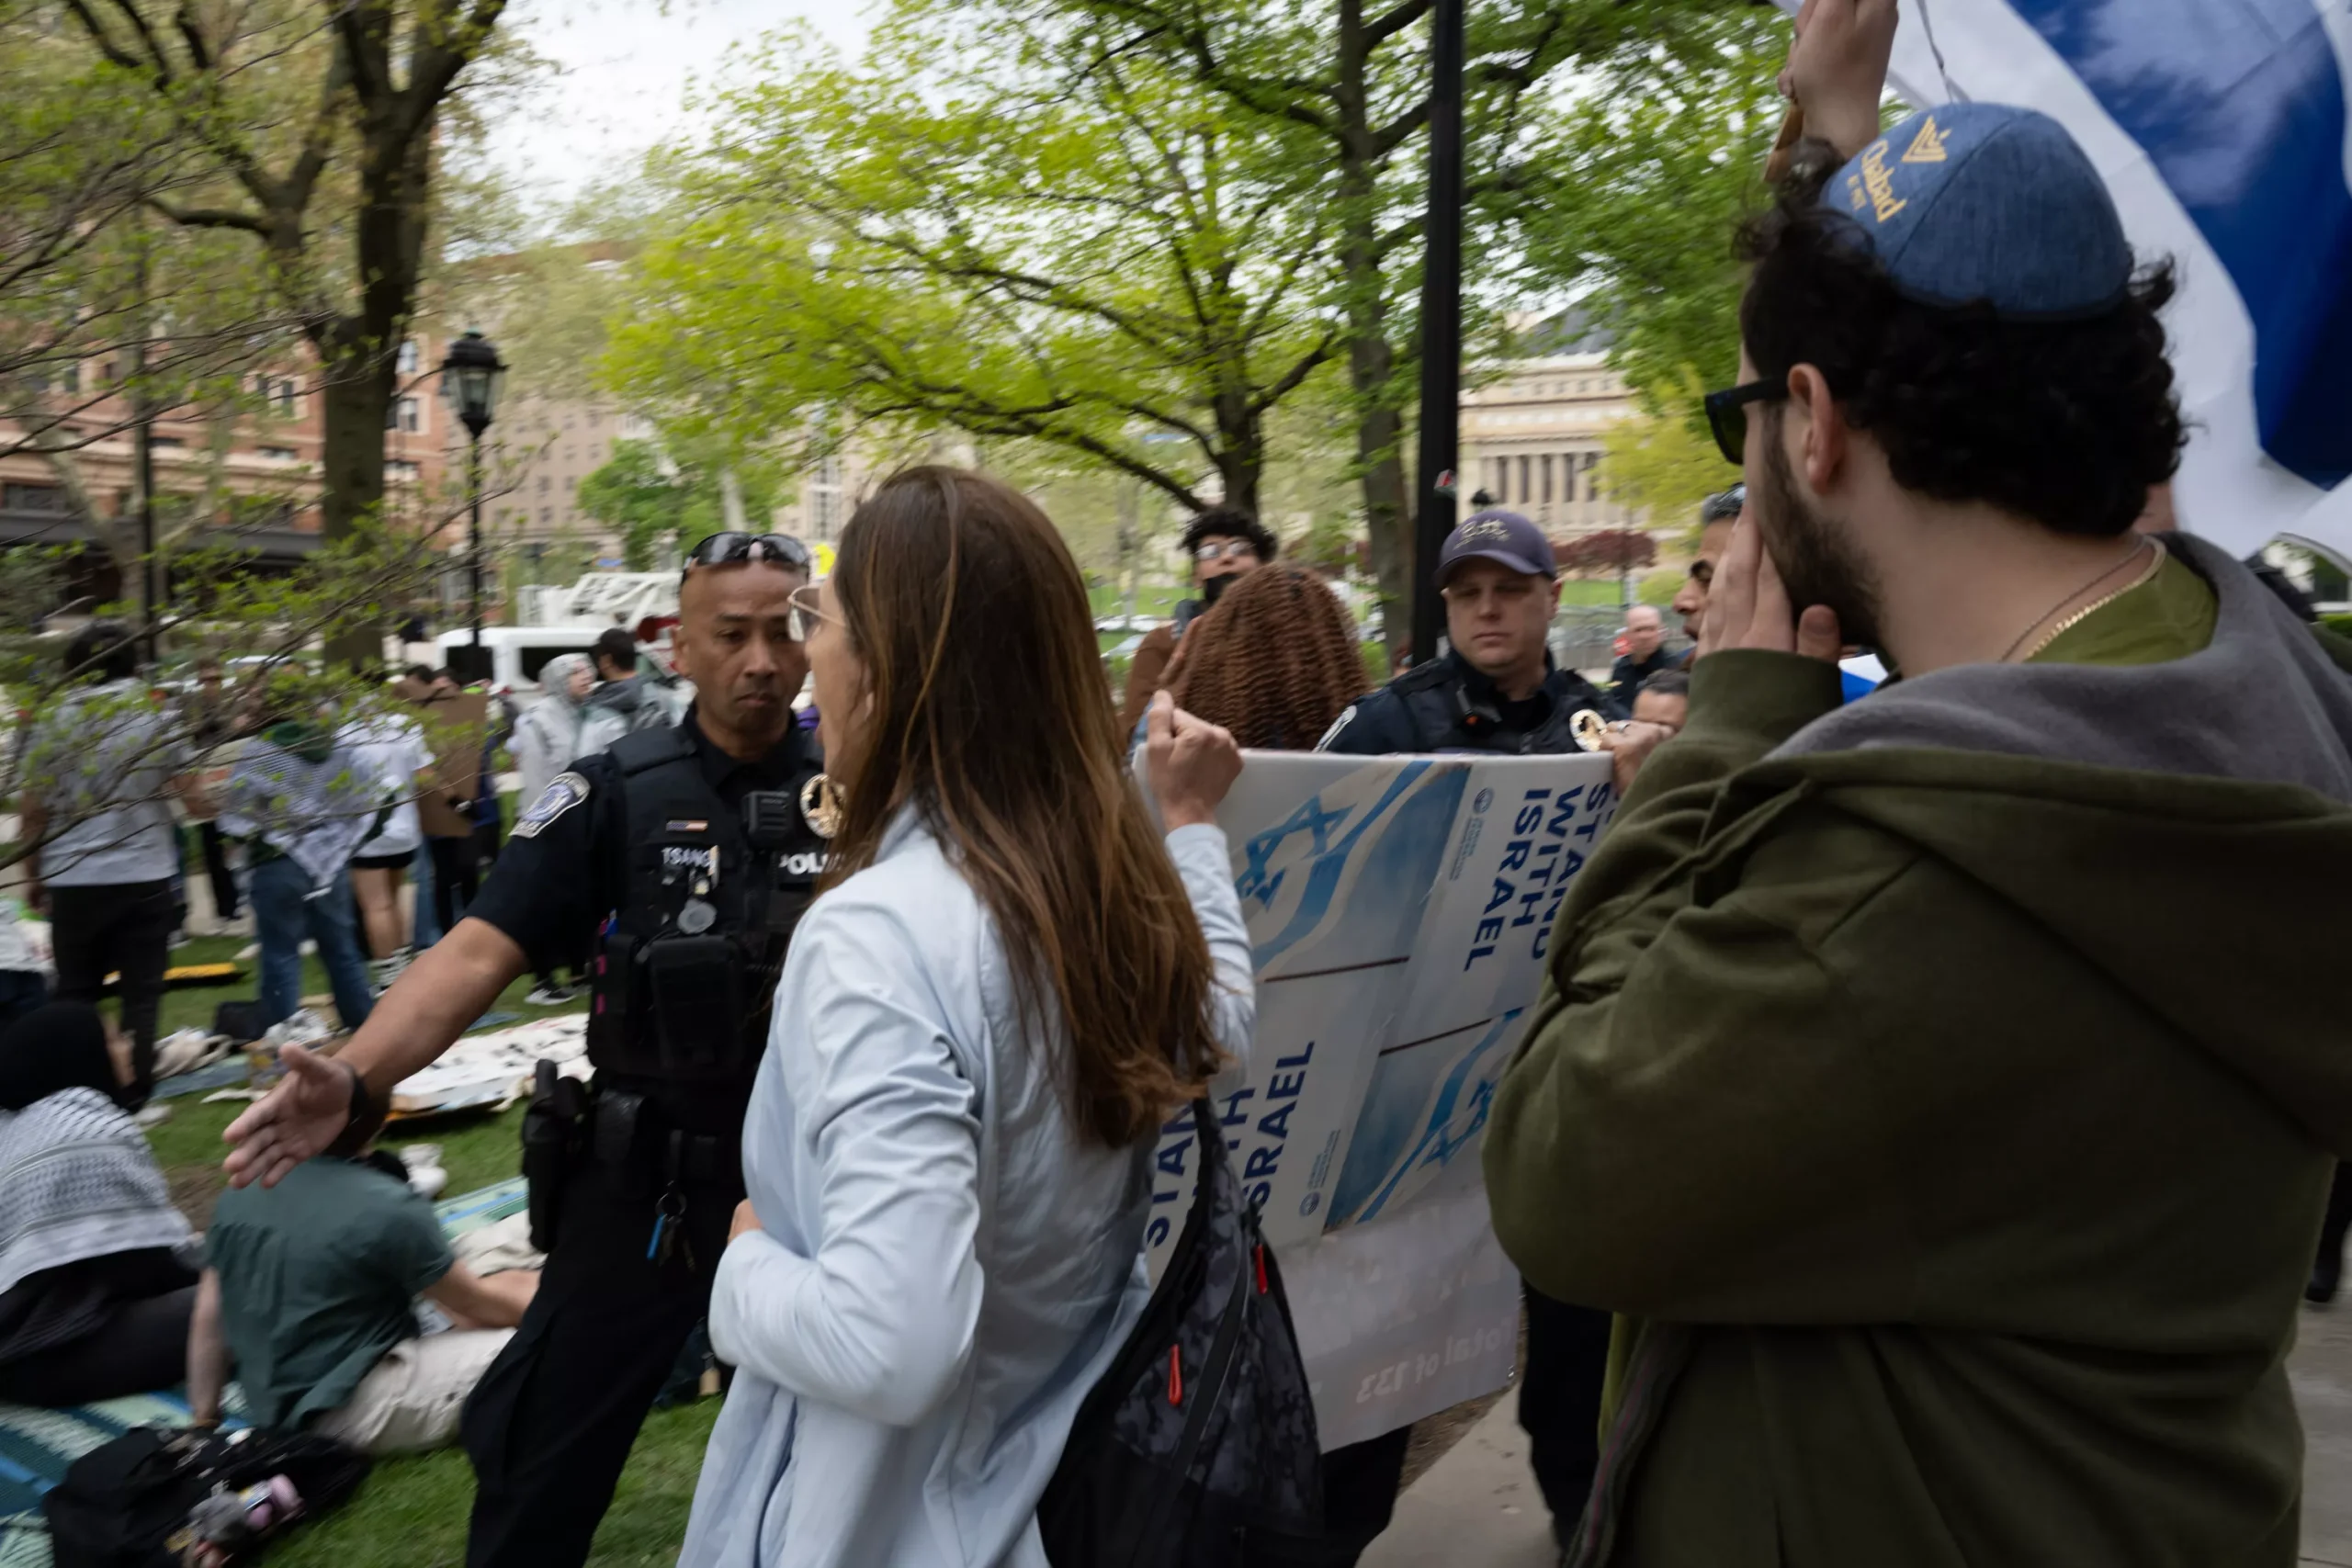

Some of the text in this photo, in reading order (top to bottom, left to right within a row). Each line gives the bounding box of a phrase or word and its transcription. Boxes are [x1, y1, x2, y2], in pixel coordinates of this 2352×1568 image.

[1463, 787, 1553, 972] ISRAEL
[1510, 783, 1586, 929] WITH
[1242, 1041, 1316, 1226] SRAEL
